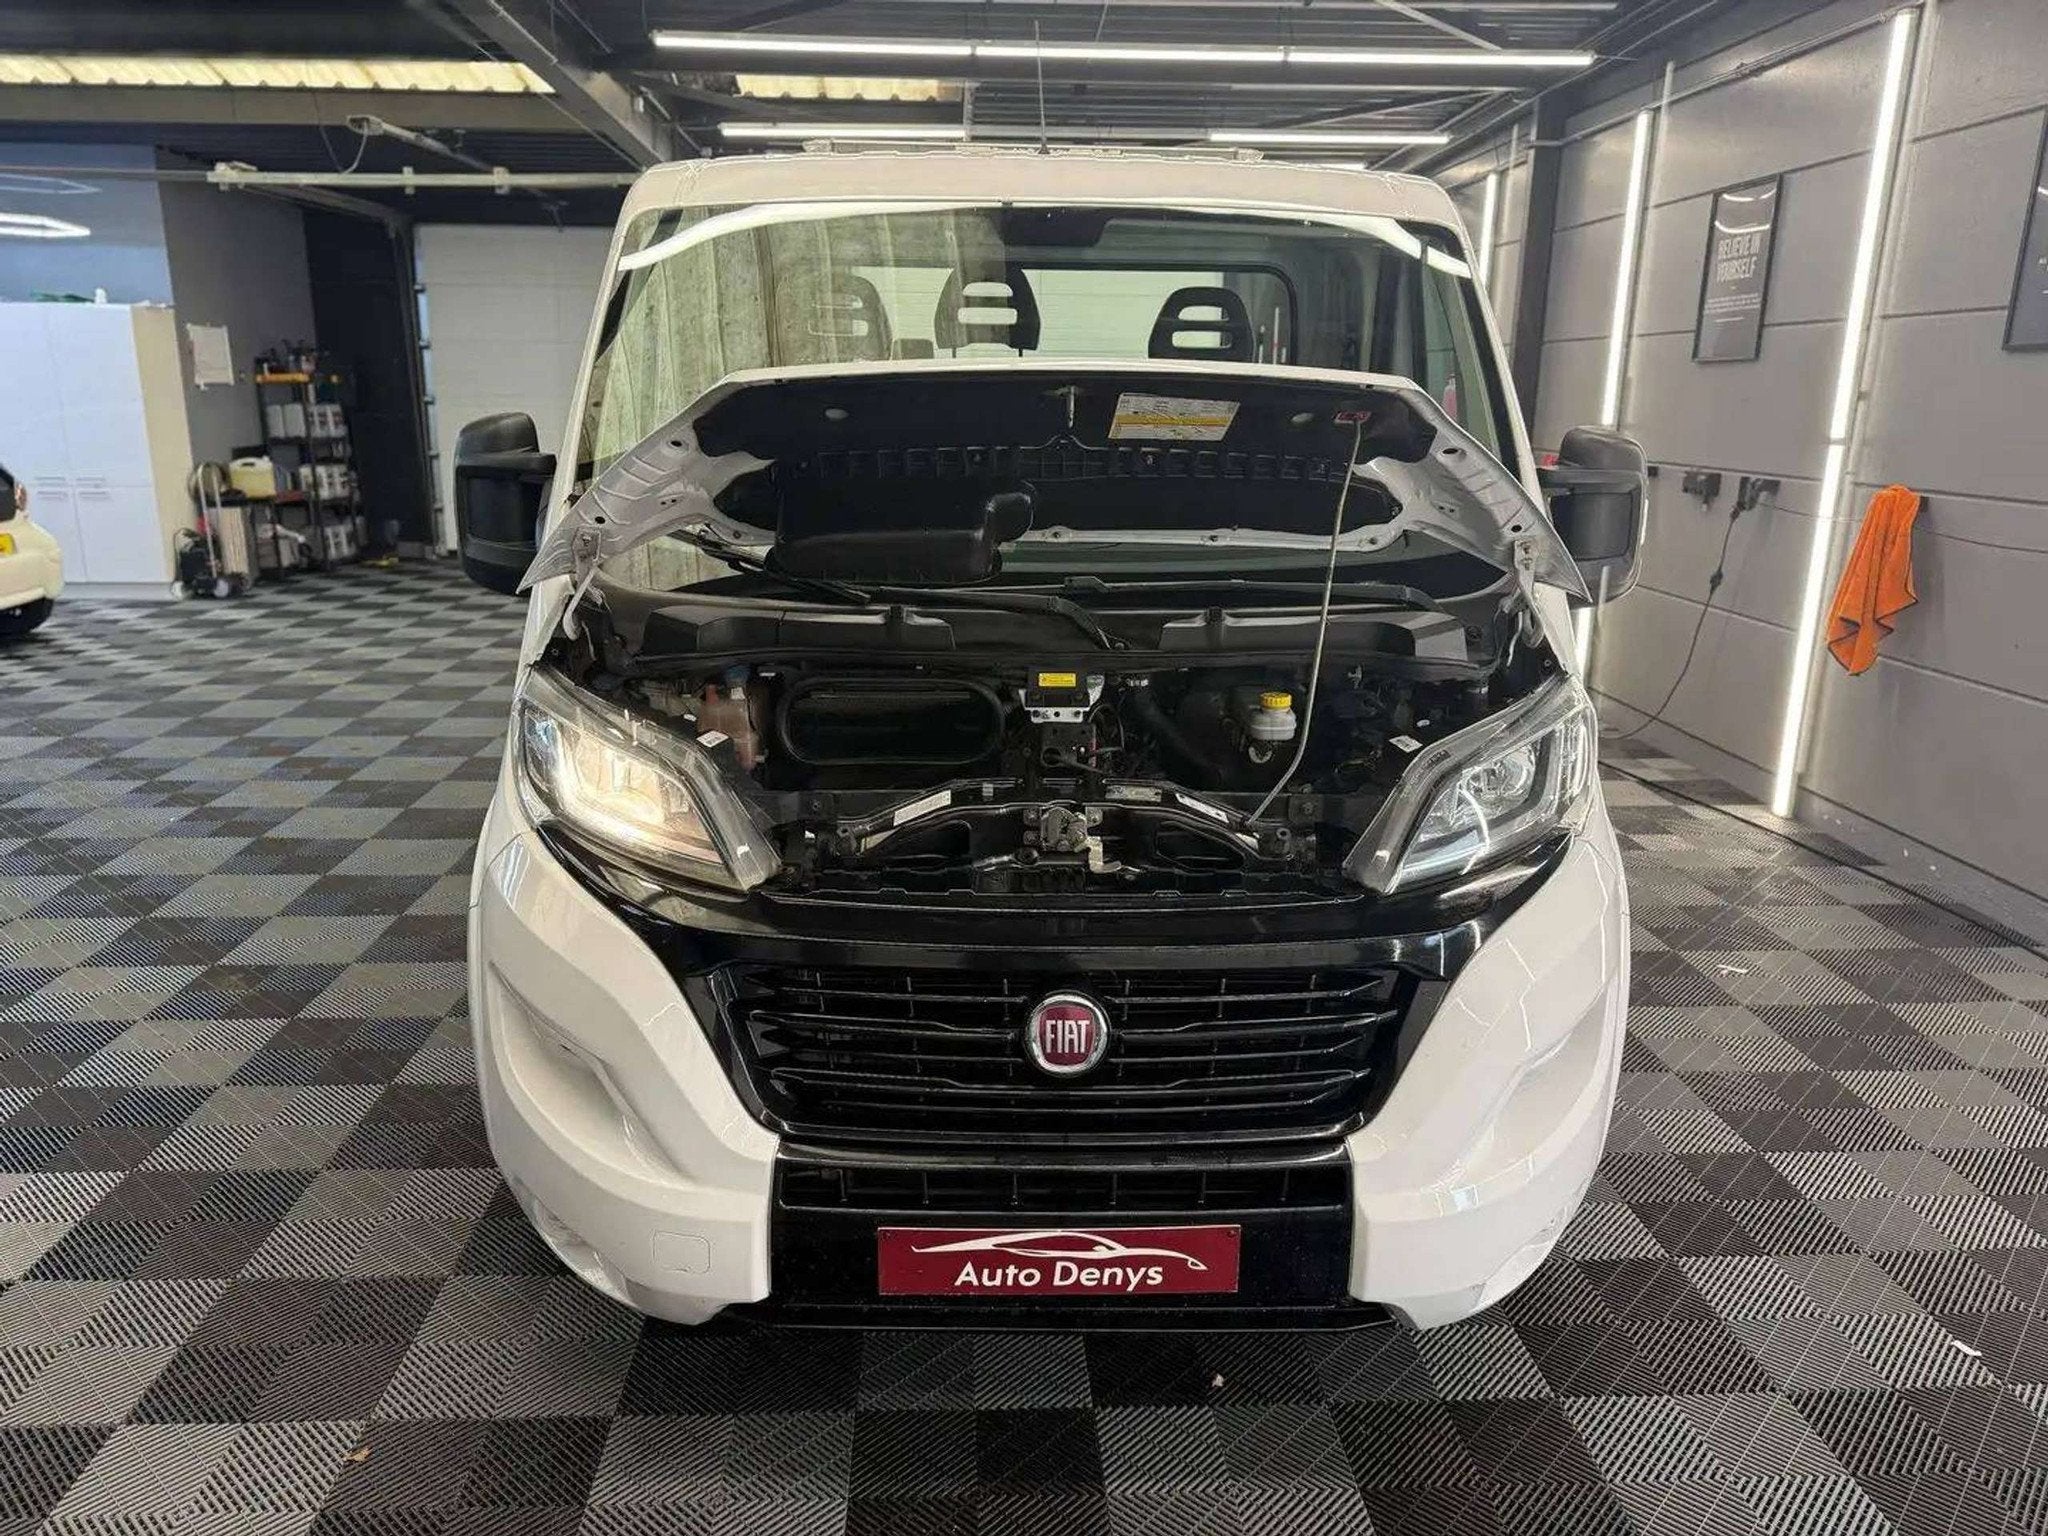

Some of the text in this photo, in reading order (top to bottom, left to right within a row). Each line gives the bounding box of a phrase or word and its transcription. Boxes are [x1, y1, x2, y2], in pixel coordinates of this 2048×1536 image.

[1718, 232, 1761, 260] BELIEVE IN
[1716, 256, 1758, 283] YOURSELF
[1045, 1019, 1091, 1054] FIAT
[954, 1261, 1164, 1292] Auto Denys
